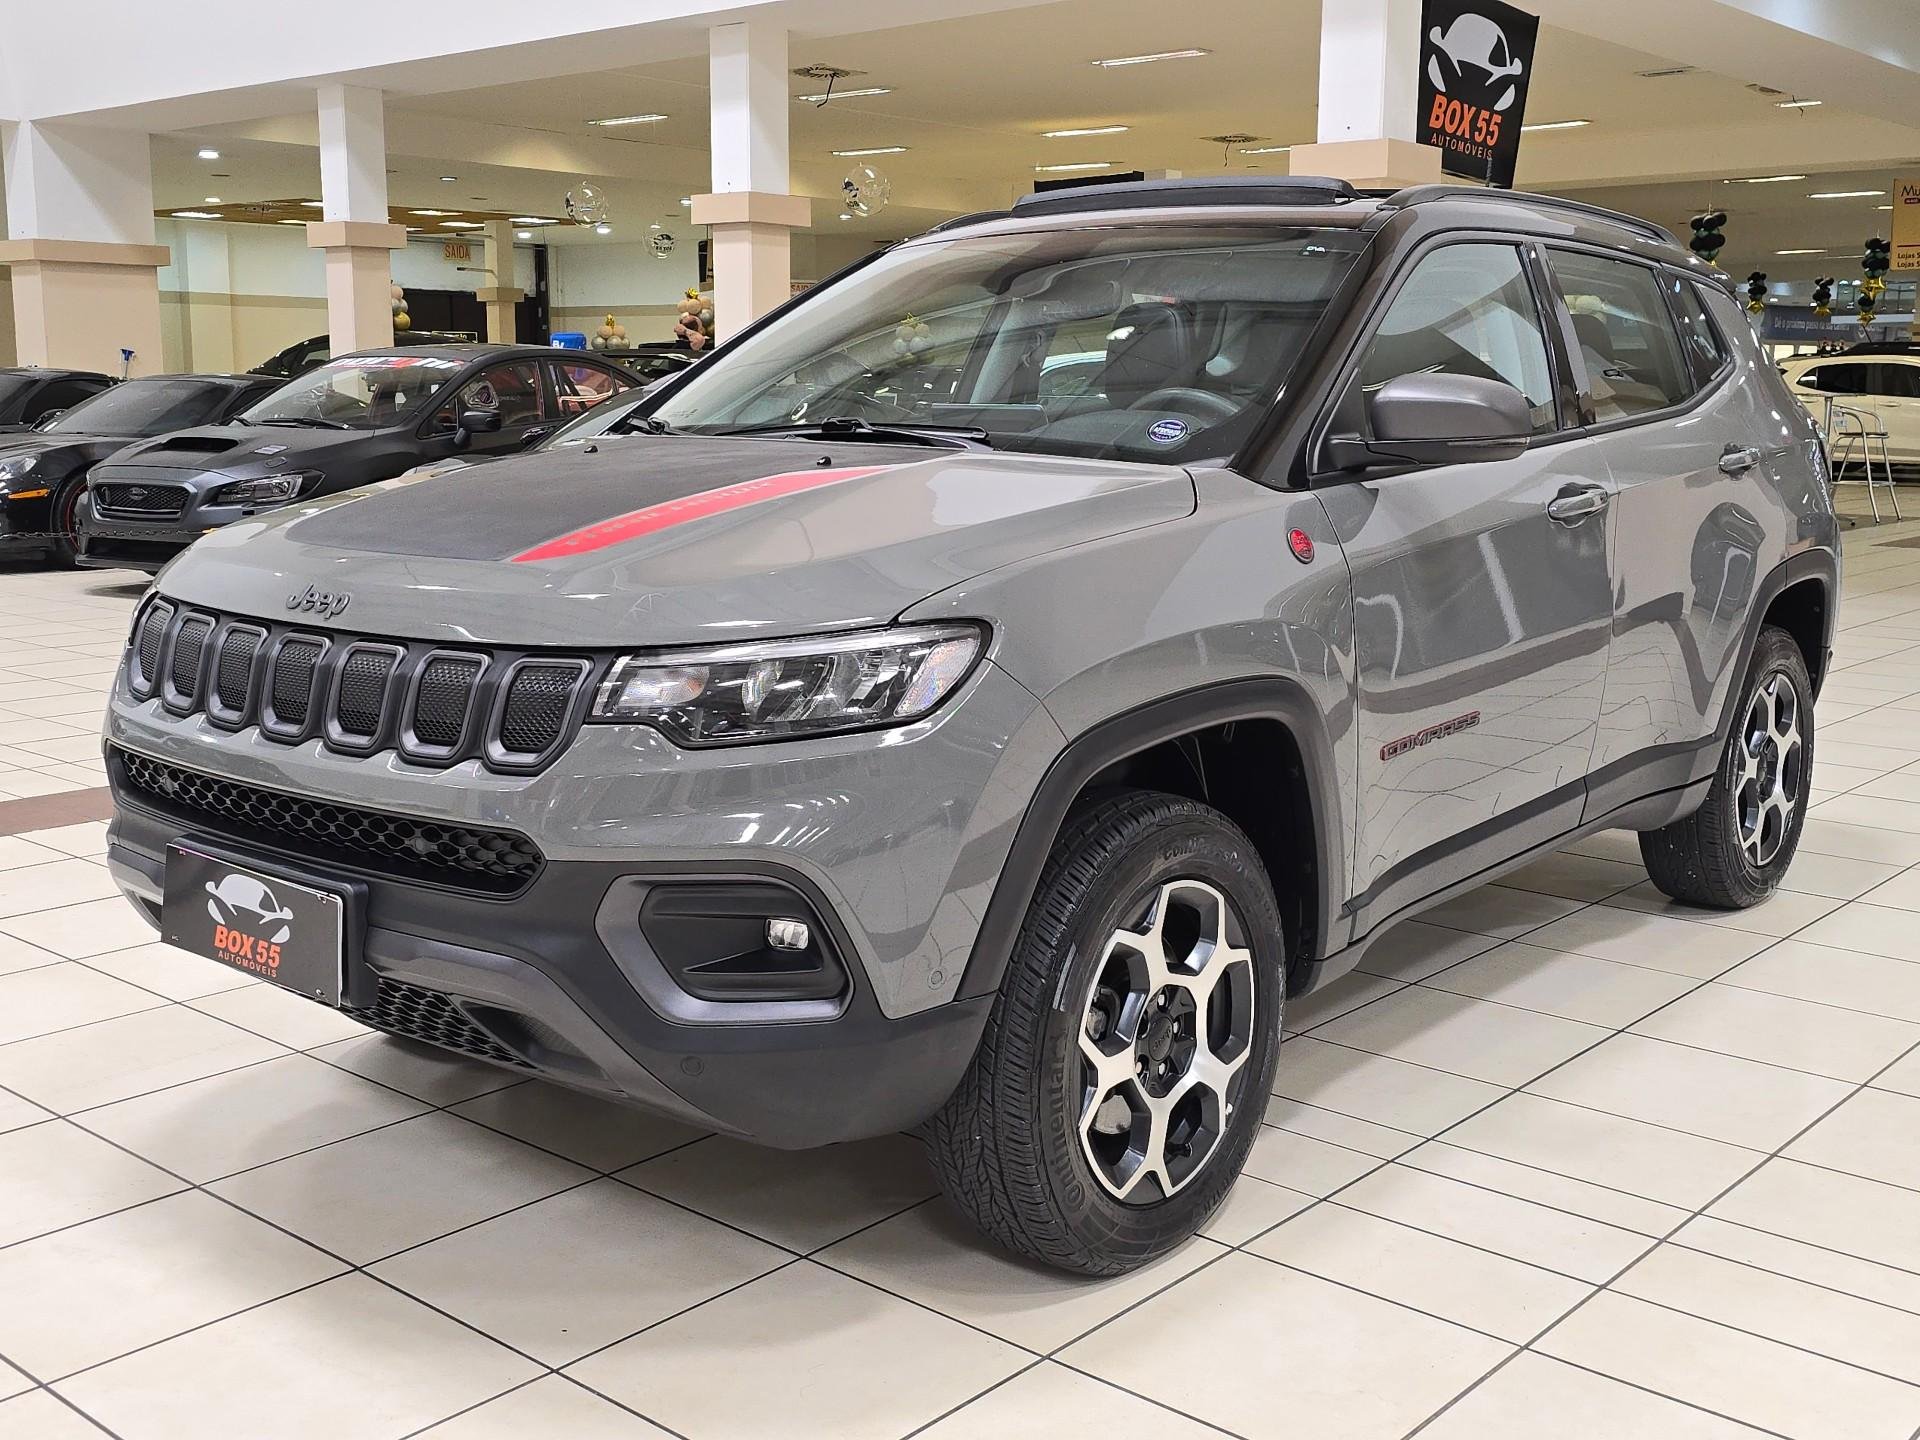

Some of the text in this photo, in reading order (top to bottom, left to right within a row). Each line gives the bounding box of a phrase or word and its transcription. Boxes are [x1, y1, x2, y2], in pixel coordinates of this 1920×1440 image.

[1429, 94, 1502, 146] BOX 55
[1430, 132, 1494, 160] AUTOMÓVEIS
[1897, 252, 1915, 260] Lojas
[1897, 261, 1914, 269] Lojas
[790, 284, 813, 293] SAID
[286, 583, 351, 620] Jeep
[1380, 710, 1481, 762] COMPASS
[214, 925, 280, 968] BOX 55
[218, 951, 277, 977] AUTOMÓVEIS
